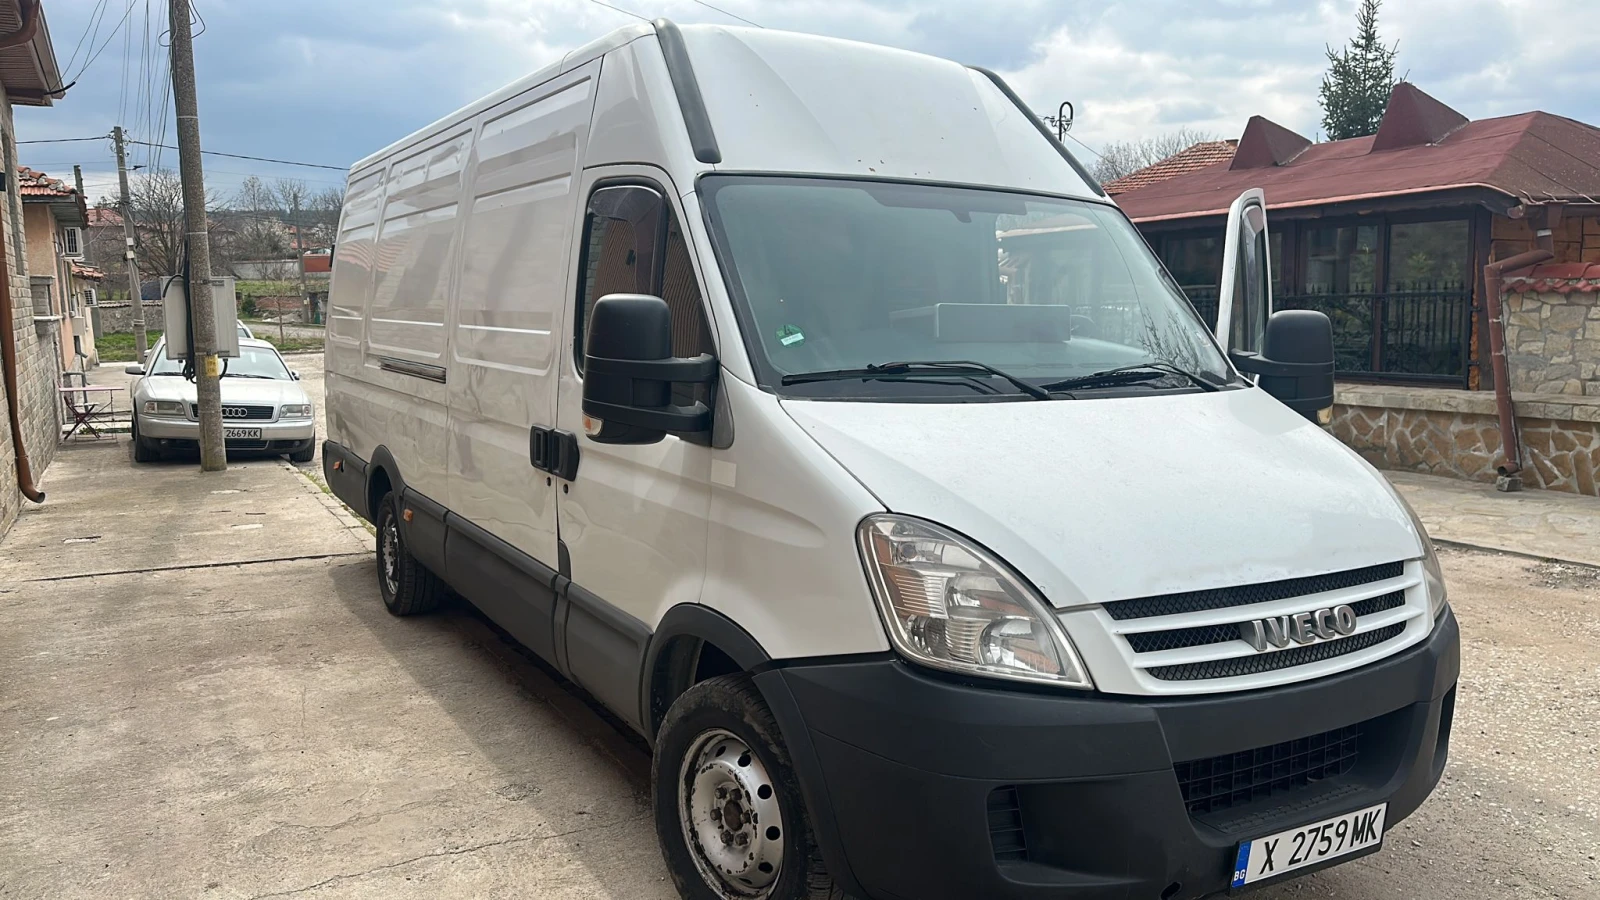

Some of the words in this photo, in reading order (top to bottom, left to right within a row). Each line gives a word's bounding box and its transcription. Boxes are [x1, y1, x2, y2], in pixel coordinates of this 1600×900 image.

[226, 429, 246, 438] 2669
[247, 429, 259, 438] KK
[1247, 604, 1357, 652] IVECO
[1259, 838, 1279, 875] X
[1288, 819, 1348, 866] 2759
[1350, 809, 1381, 848] MK
[1233, 870, 1246, 881] BG
